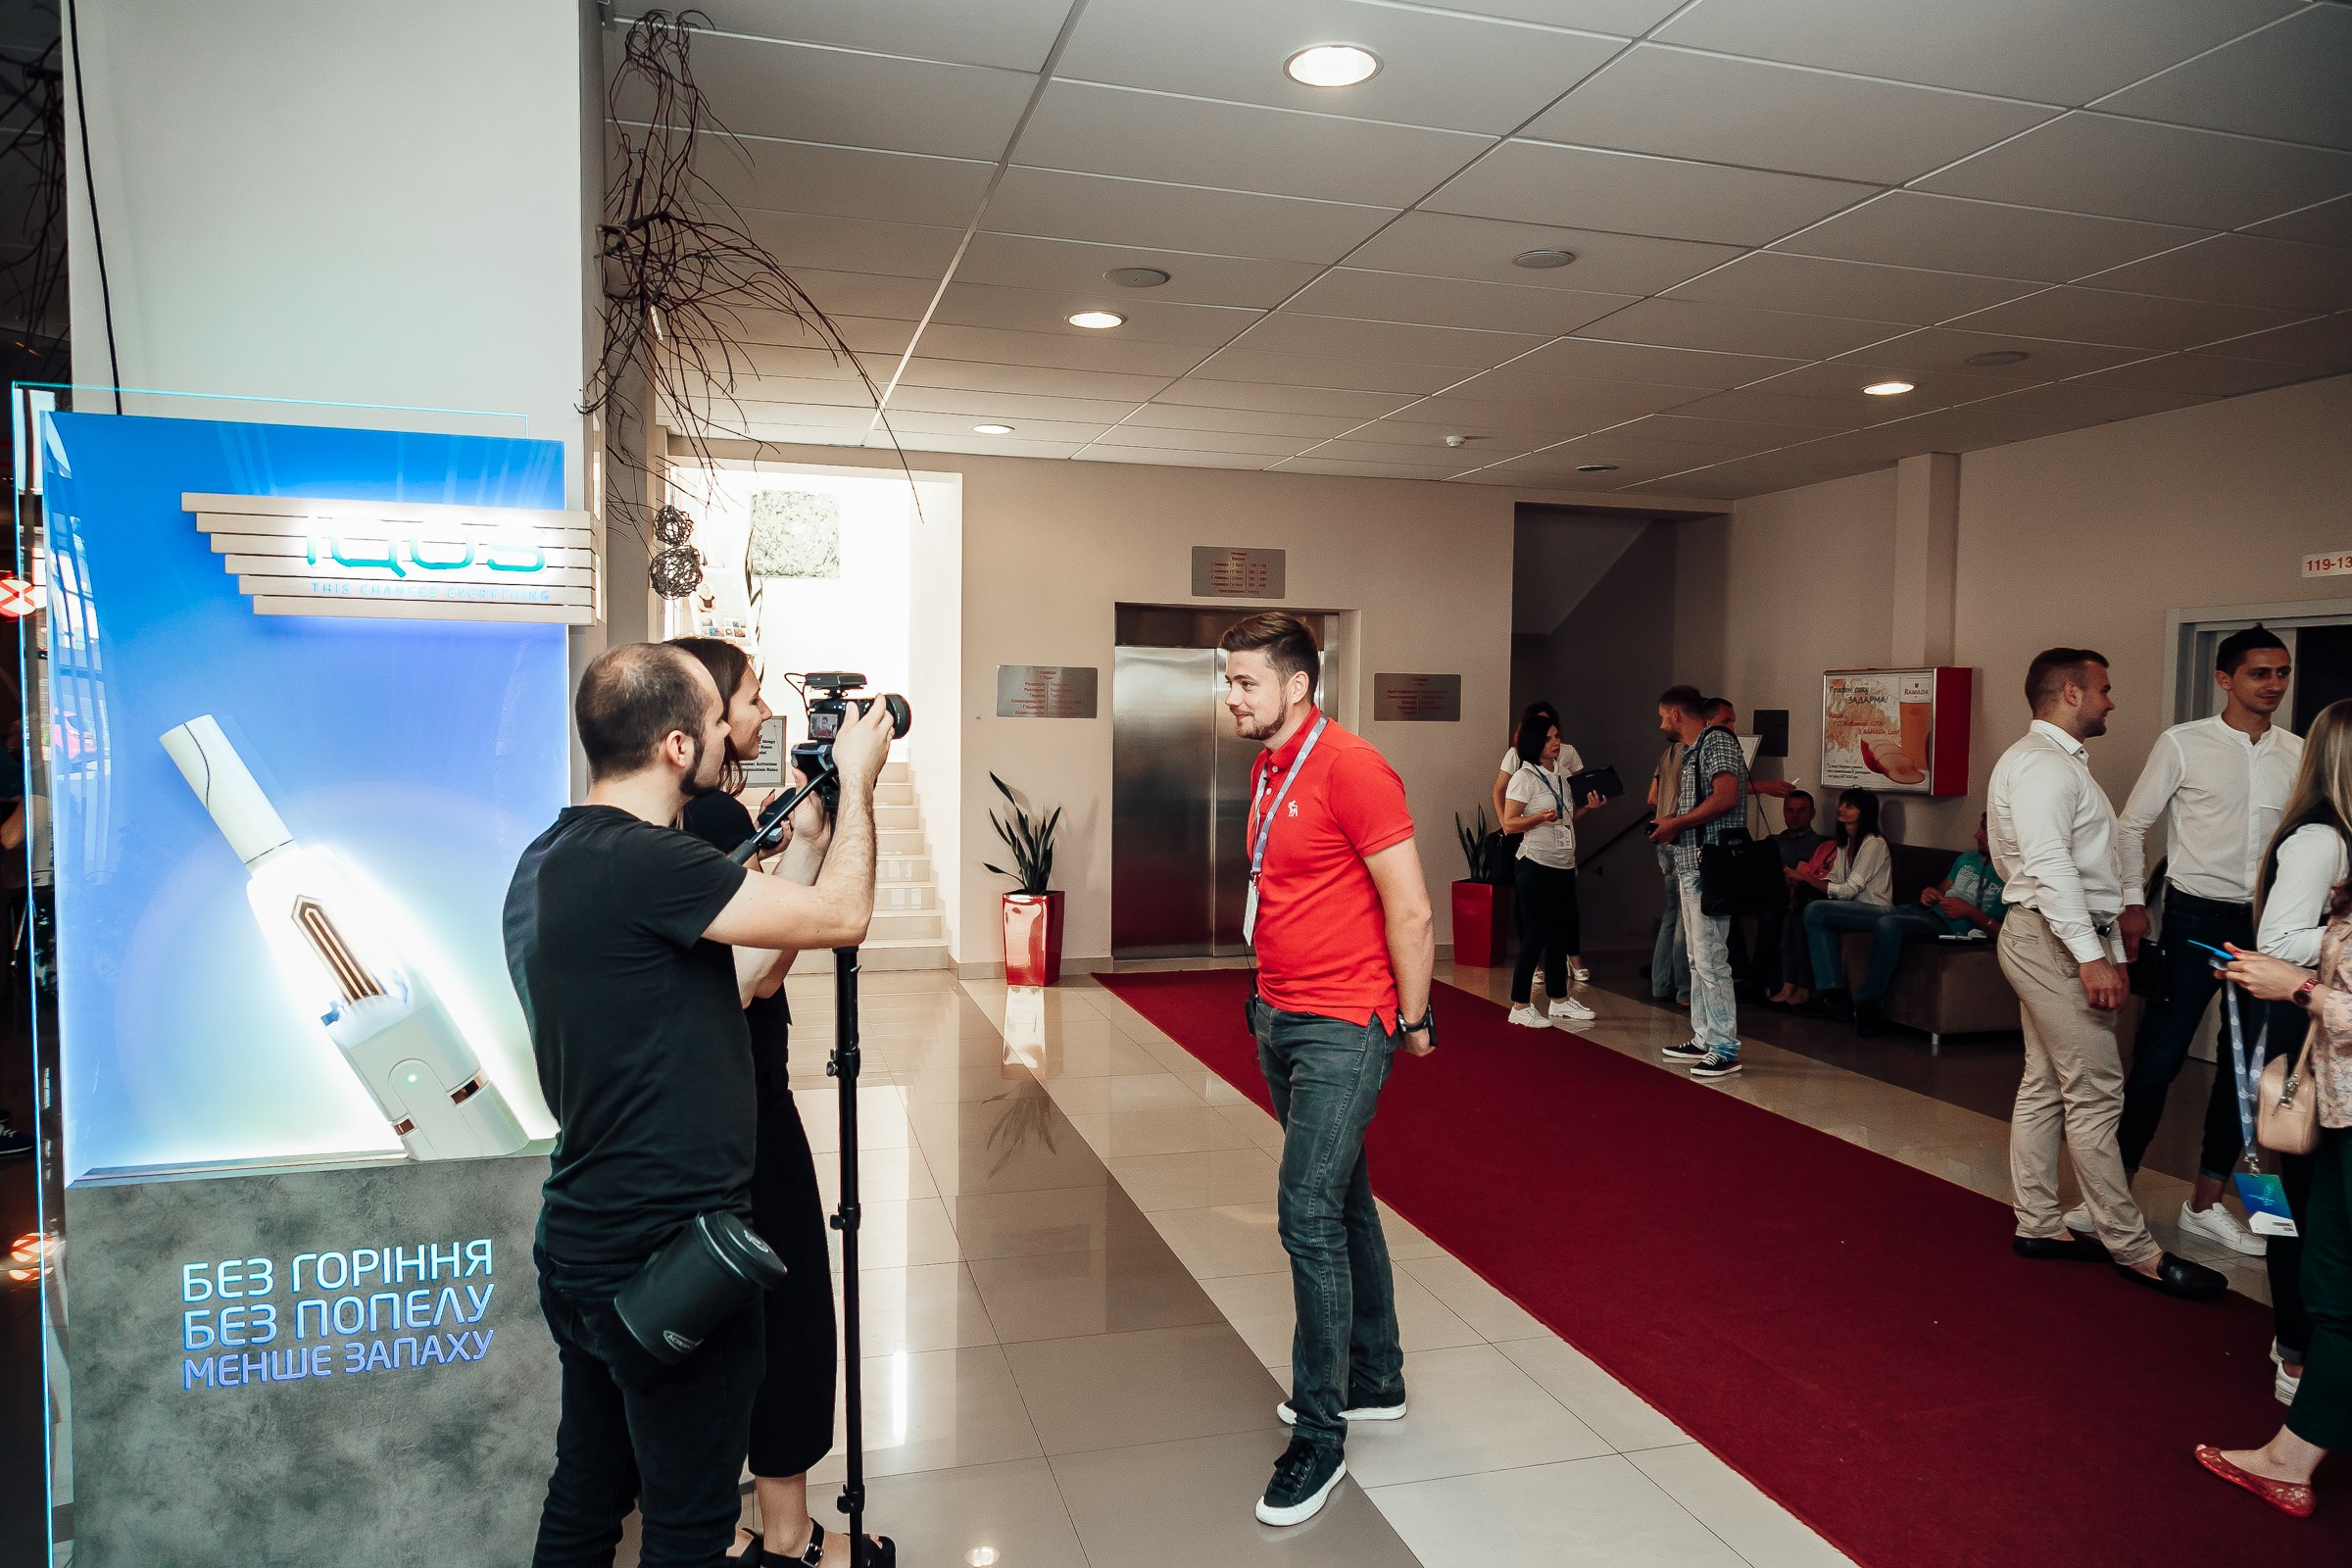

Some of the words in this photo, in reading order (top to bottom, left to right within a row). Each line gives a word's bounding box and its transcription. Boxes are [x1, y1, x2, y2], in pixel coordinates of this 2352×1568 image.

[306, 516, 547, 578] IQOS
[311, 581, 351, 595] THIS
[360, 583, 438, 598] CHANGES
[448, 588, 550, 602] EVERYTHING
[182, 1256, 274, 1302] БЕЗ
[292, 1238, 494, 1294] ГОРІННЯ
[182, 1302, 278, 1351] БЕЗ
[295, 1283, 496, 1341] ПОПЕЛУ
[183, 1344, 333, 1392] МЕНШЕ
[344, 1329, 495, 1374] ЗАПАХУ
